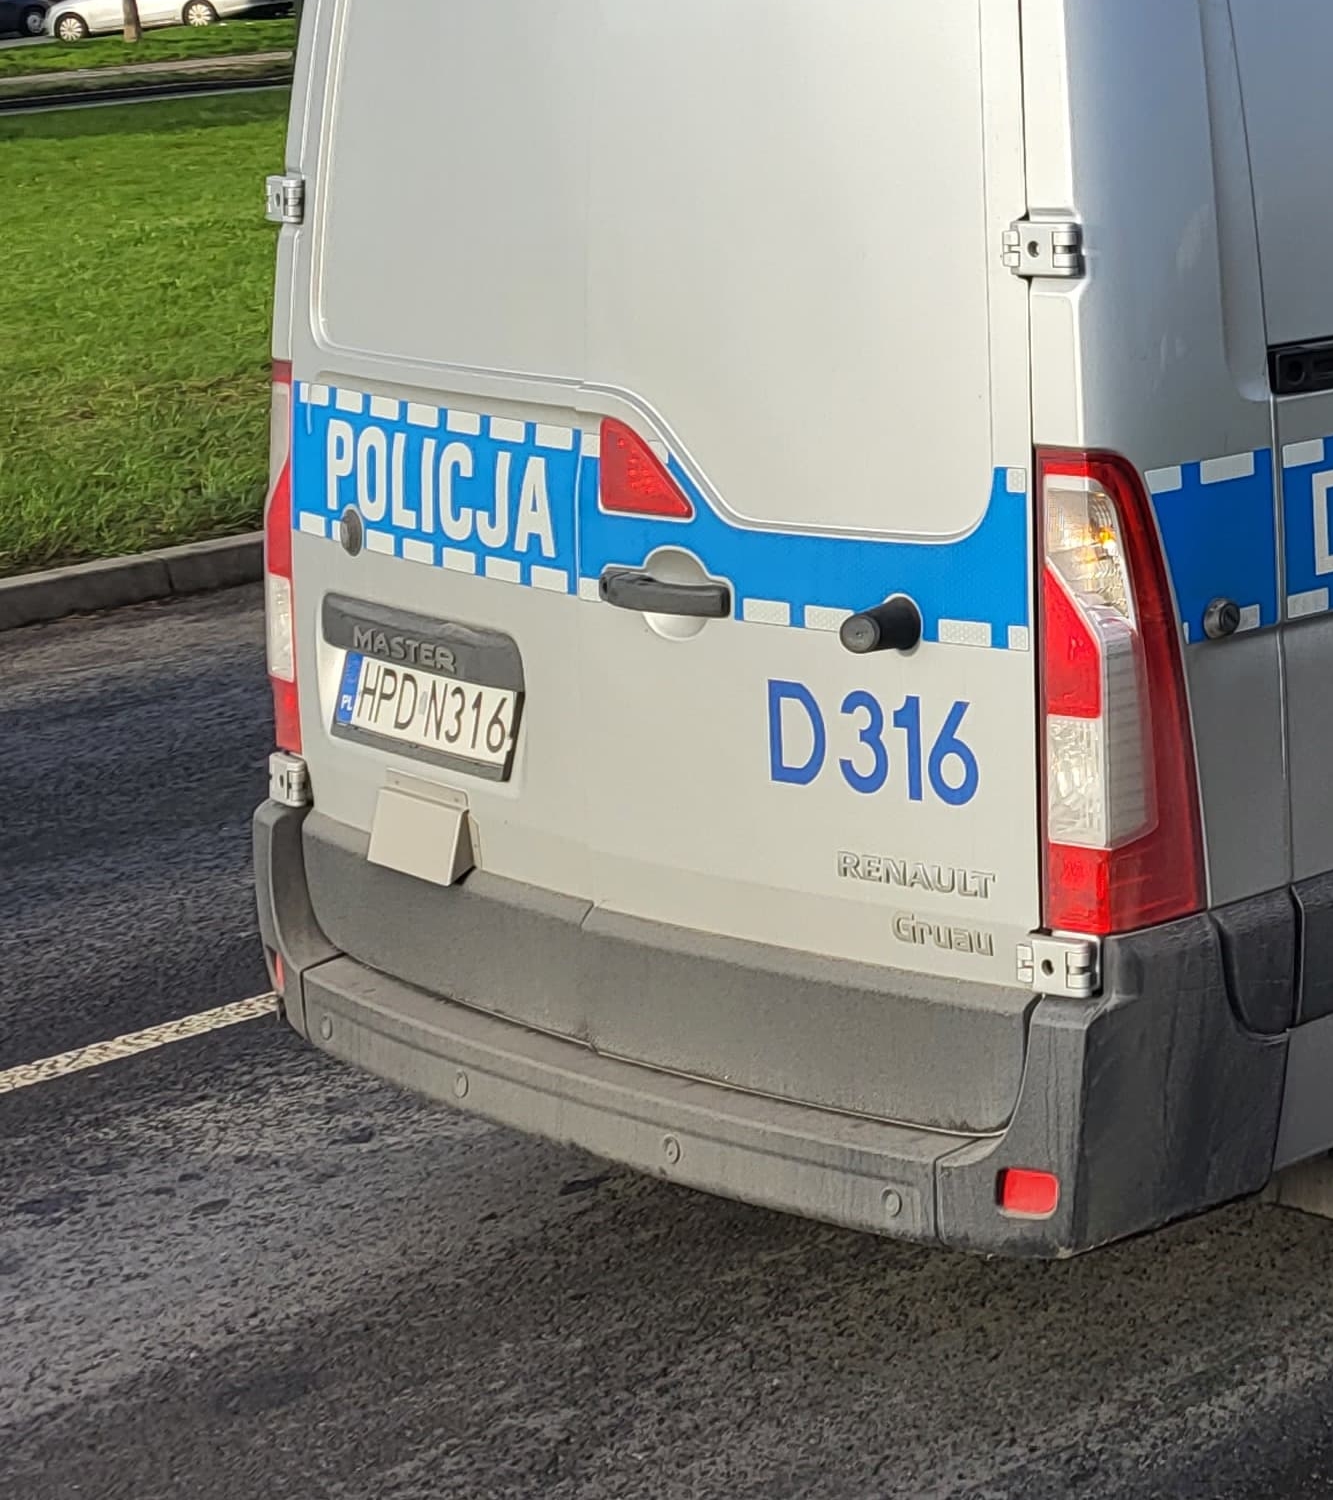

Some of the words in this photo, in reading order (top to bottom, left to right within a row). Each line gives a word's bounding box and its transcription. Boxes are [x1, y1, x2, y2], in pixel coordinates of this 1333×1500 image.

[326, 418, 557, 559] POLICJA
[353, 625, 458, 674] MASTER
[340, 694, 353, 712] PL
[767, 678, 827, 786] D
[838, 689, 980, 807] 316
[837, 850, 997, 899] RENAULT
[891, 910, 994, 957] Gruau
